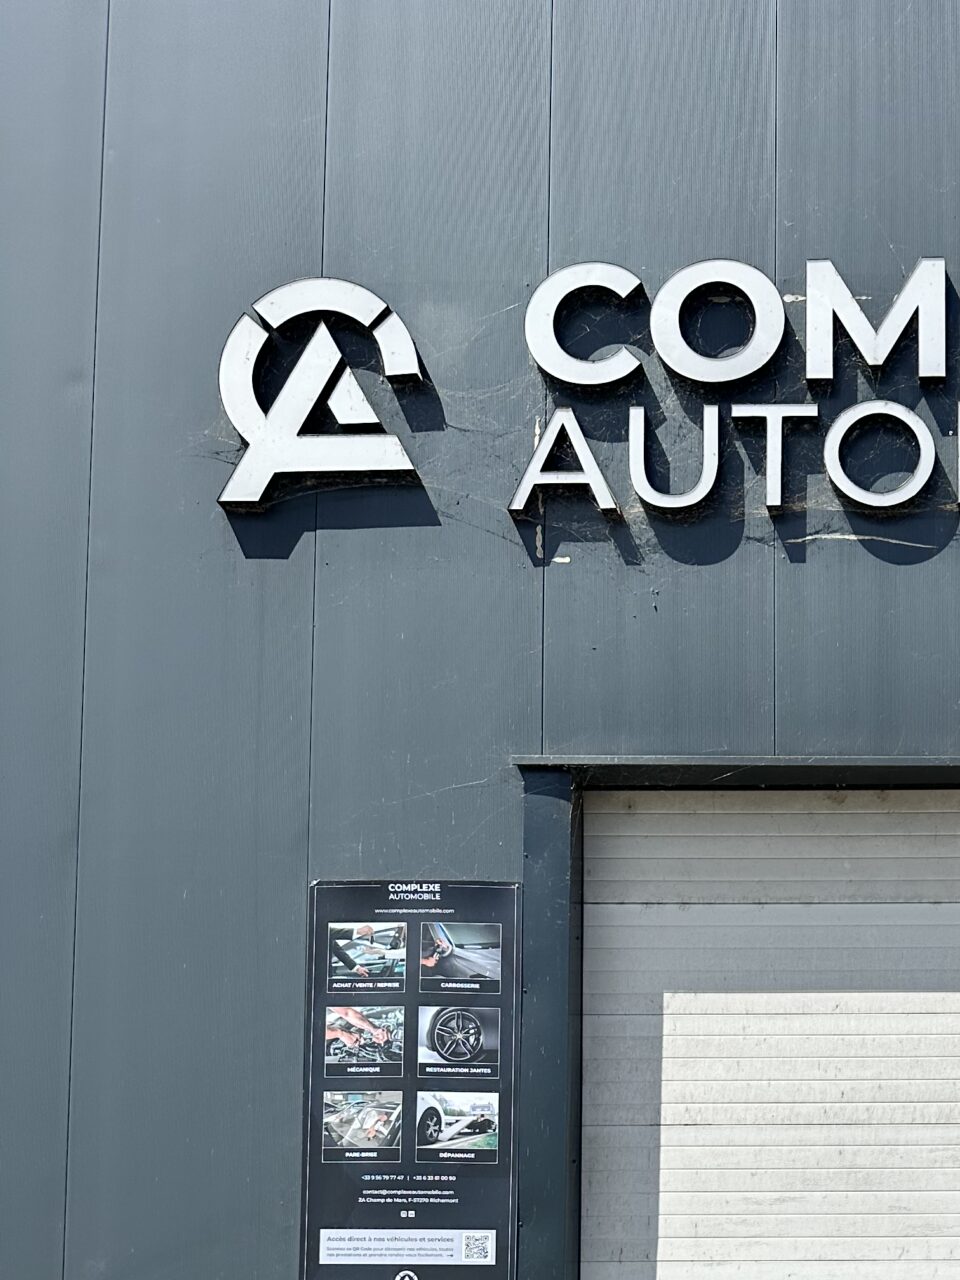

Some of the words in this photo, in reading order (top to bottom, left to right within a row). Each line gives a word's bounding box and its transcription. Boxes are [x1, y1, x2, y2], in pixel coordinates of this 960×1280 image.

[388, 883, 441, 892] COMPLEXE
[347, 1065, 381, 1073] MÉCANIQUE
[439, 1151, 475, 1159] DÉPANNAGE
